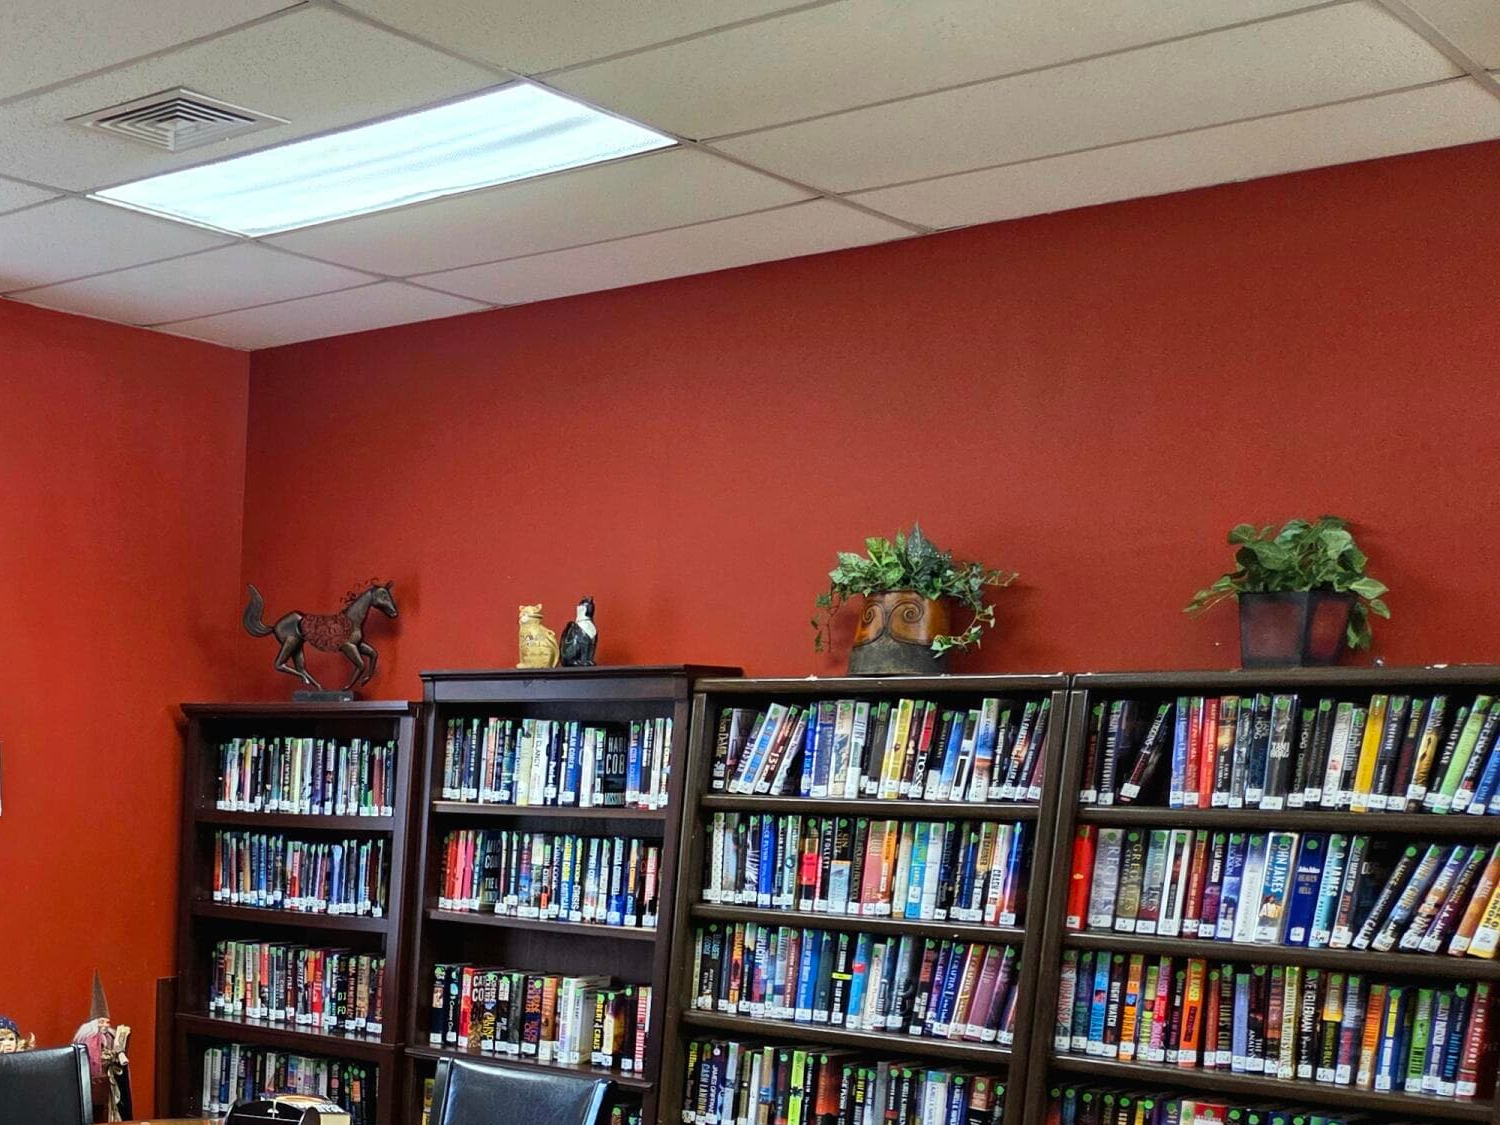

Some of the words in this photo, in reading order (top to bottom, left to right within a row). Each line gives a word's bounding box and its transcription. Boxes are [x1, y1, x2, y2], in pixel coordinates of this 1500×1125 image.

[1272, 866, 1286, 893] JAKES
[1327, 867, 1341, 897] JAMES
[1301, 990, 1319, 1032] KELLERMAN
[593, 1029, 602, 1050] CRAIS
[1247, 1029, 1257, 1058] ANALYS
